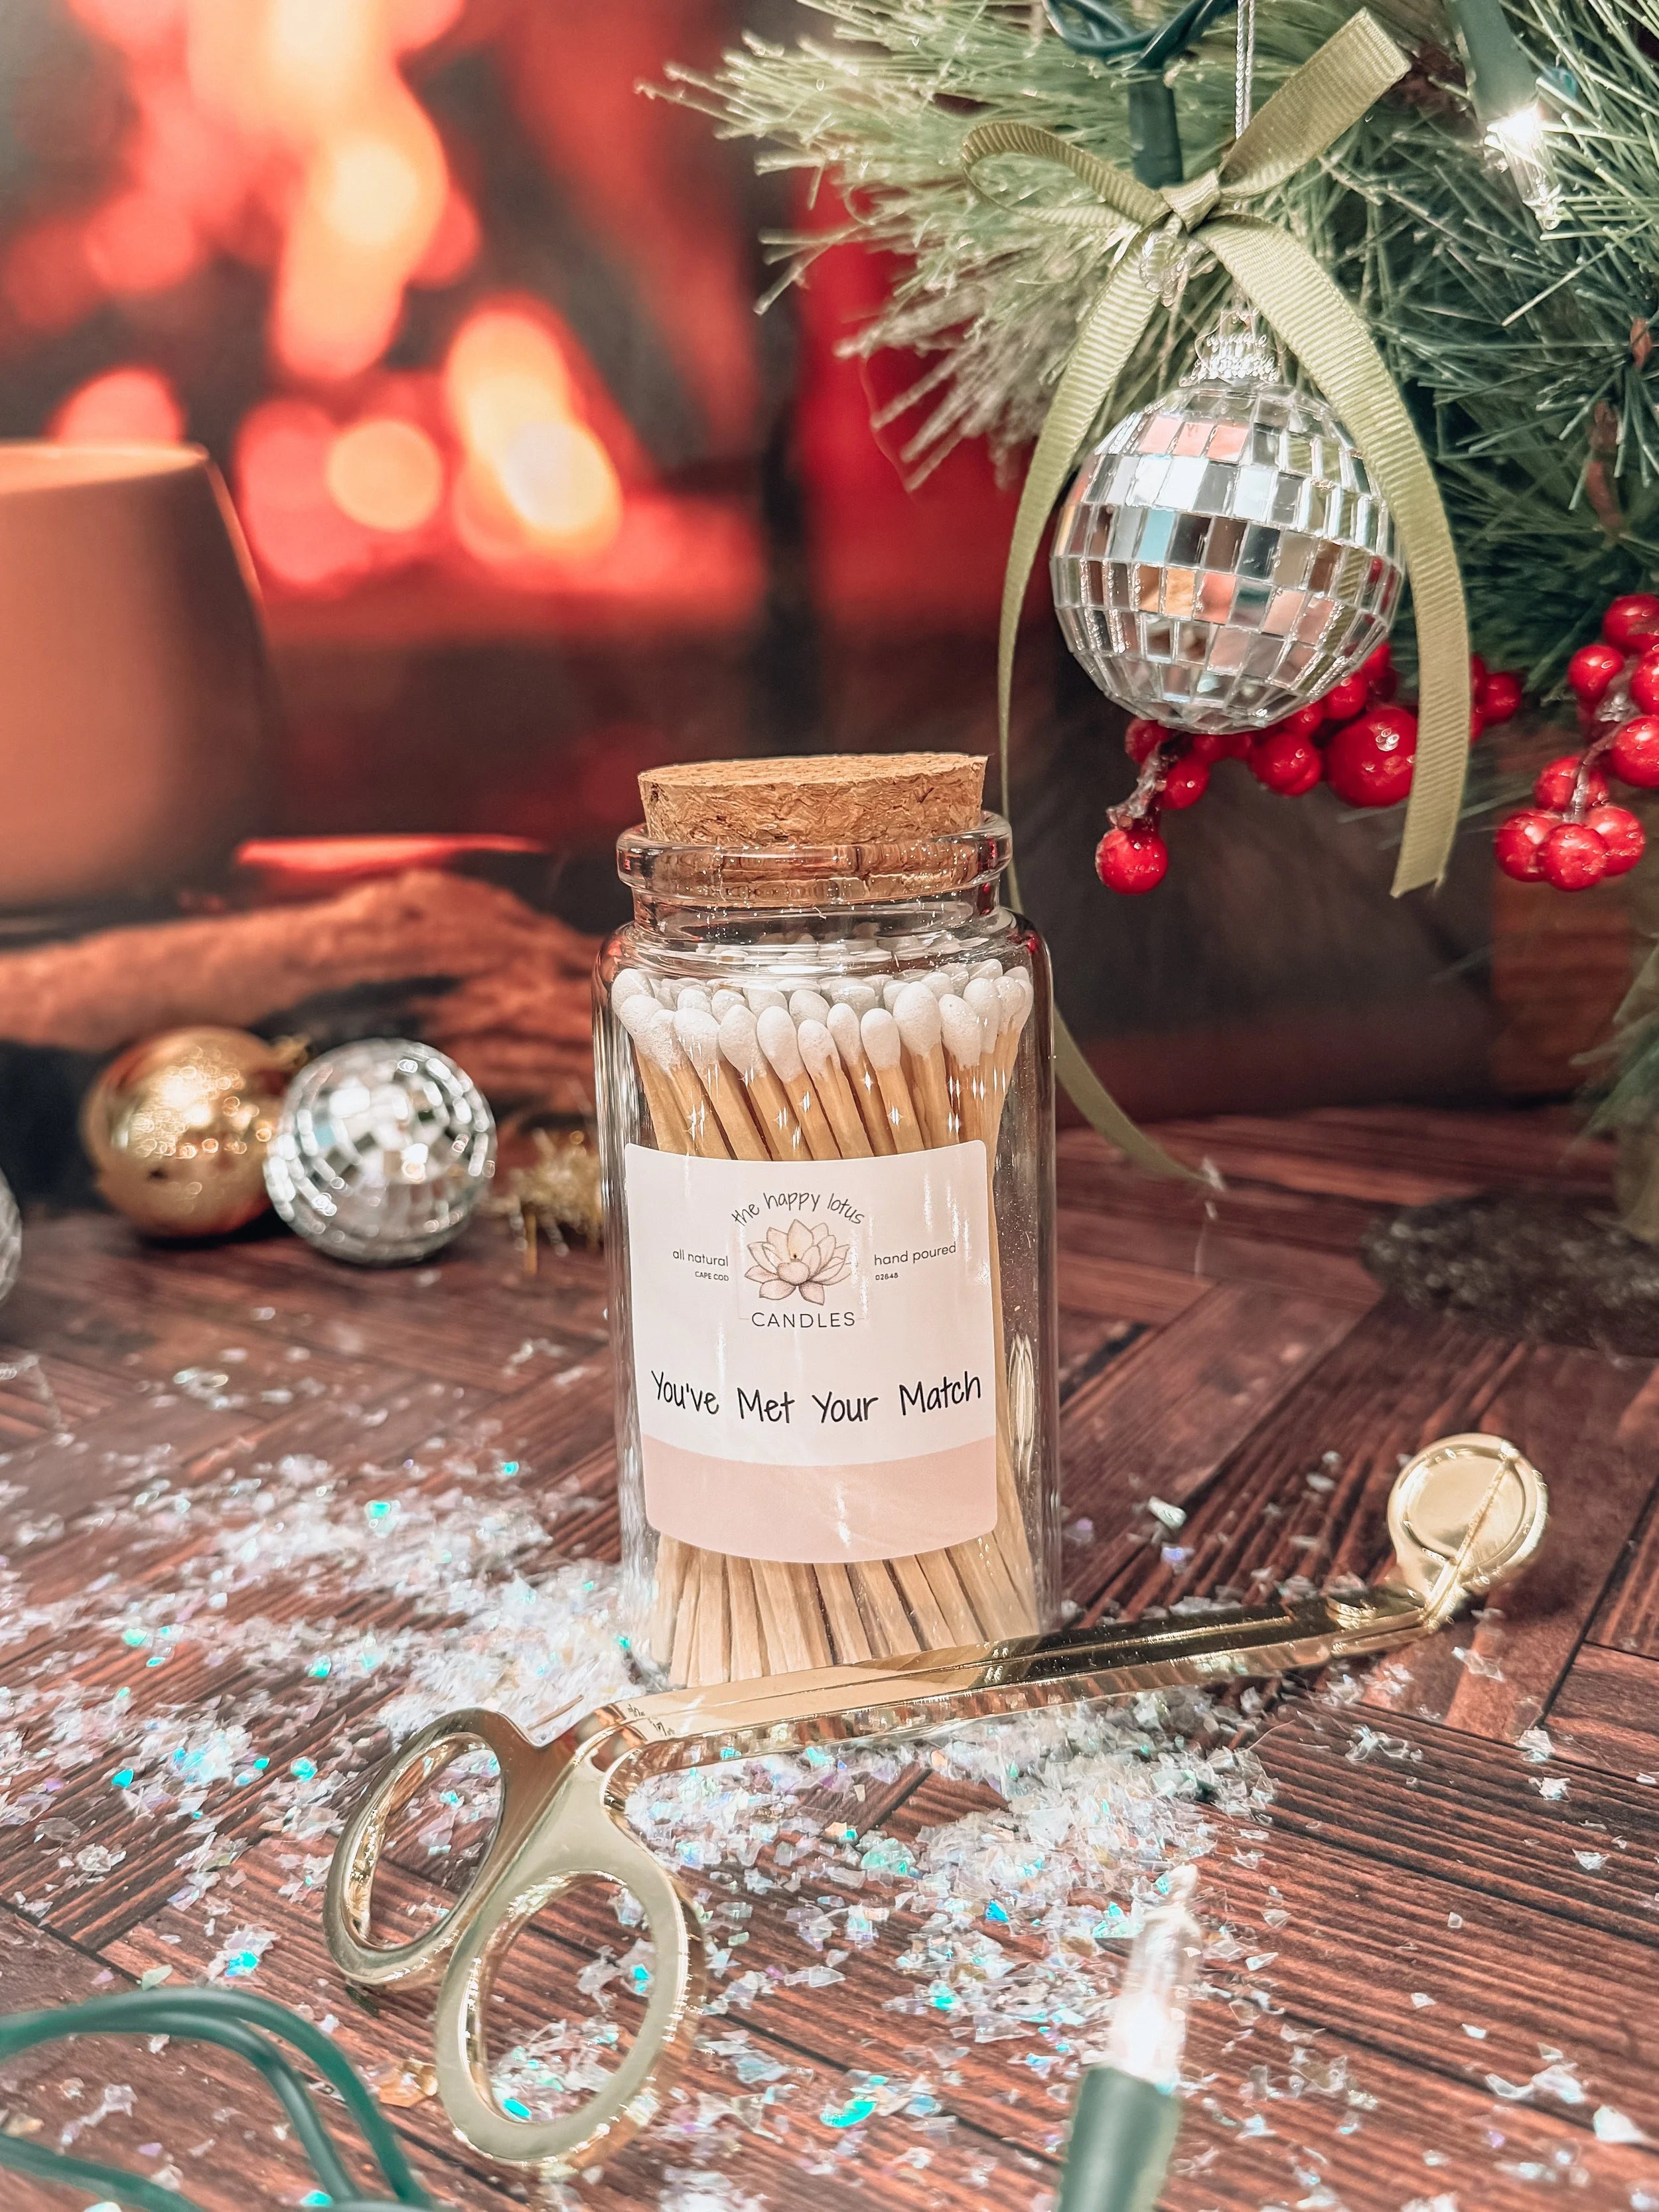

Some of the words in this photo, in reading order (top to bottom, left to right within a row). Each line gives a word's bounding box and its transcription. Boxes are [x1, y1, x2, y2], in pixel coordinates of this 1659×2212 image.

[731, 1203, 760, 1226] the
[763, 1192, 820, 1212] happy
[827, 1193, 865, 1225] lotus
[672, 1248, 685, 1260] all
[687, 1253, 729, 1267] natural
[874, 1250, 908, 1266] hand
[912, 1241, 956, 1264] poured
[694, 1271, 712, 1280] CAPE
[713, 1273, 729, 1282] COD
[751, 1311, 855, 1329] CANDLES
[650, 1370, 719, 1415] You've
[737, 1387, 796, 1424] Met
[811, 1390, 879, 1424] Your
[899, 1370, 981, 1416] Match
